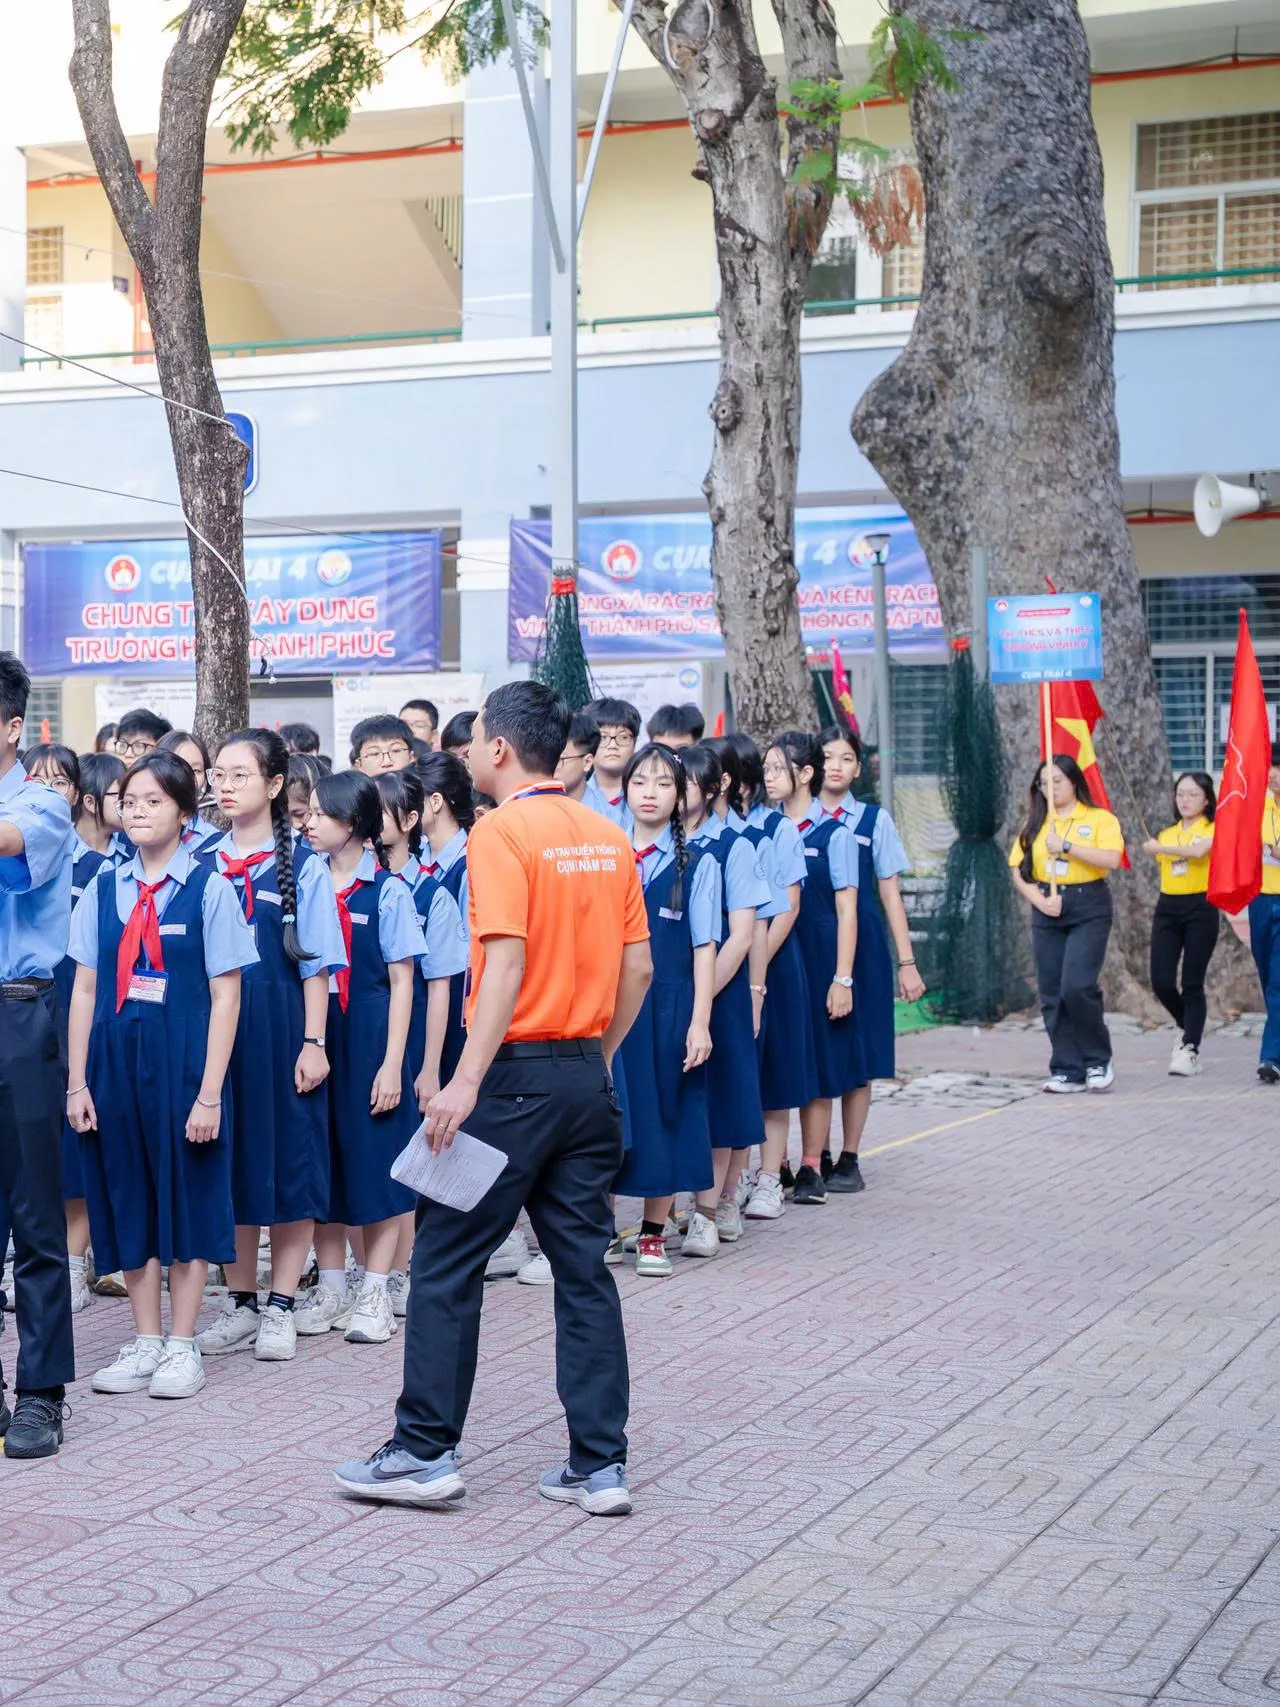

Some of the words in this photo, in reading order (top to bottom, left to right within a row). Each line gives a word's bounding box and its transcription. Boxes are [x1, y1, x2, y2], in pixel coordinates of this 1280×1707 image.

[812, 540, 838, 566] 4
[150, 561, 191, 591] CỤ
[287, 556, 308, 579] 4
[82, 602, 173, 629] CHUNG
[800, 609, 859, 631] HÔNG
[318, 626, 396, 659] PHÚC
